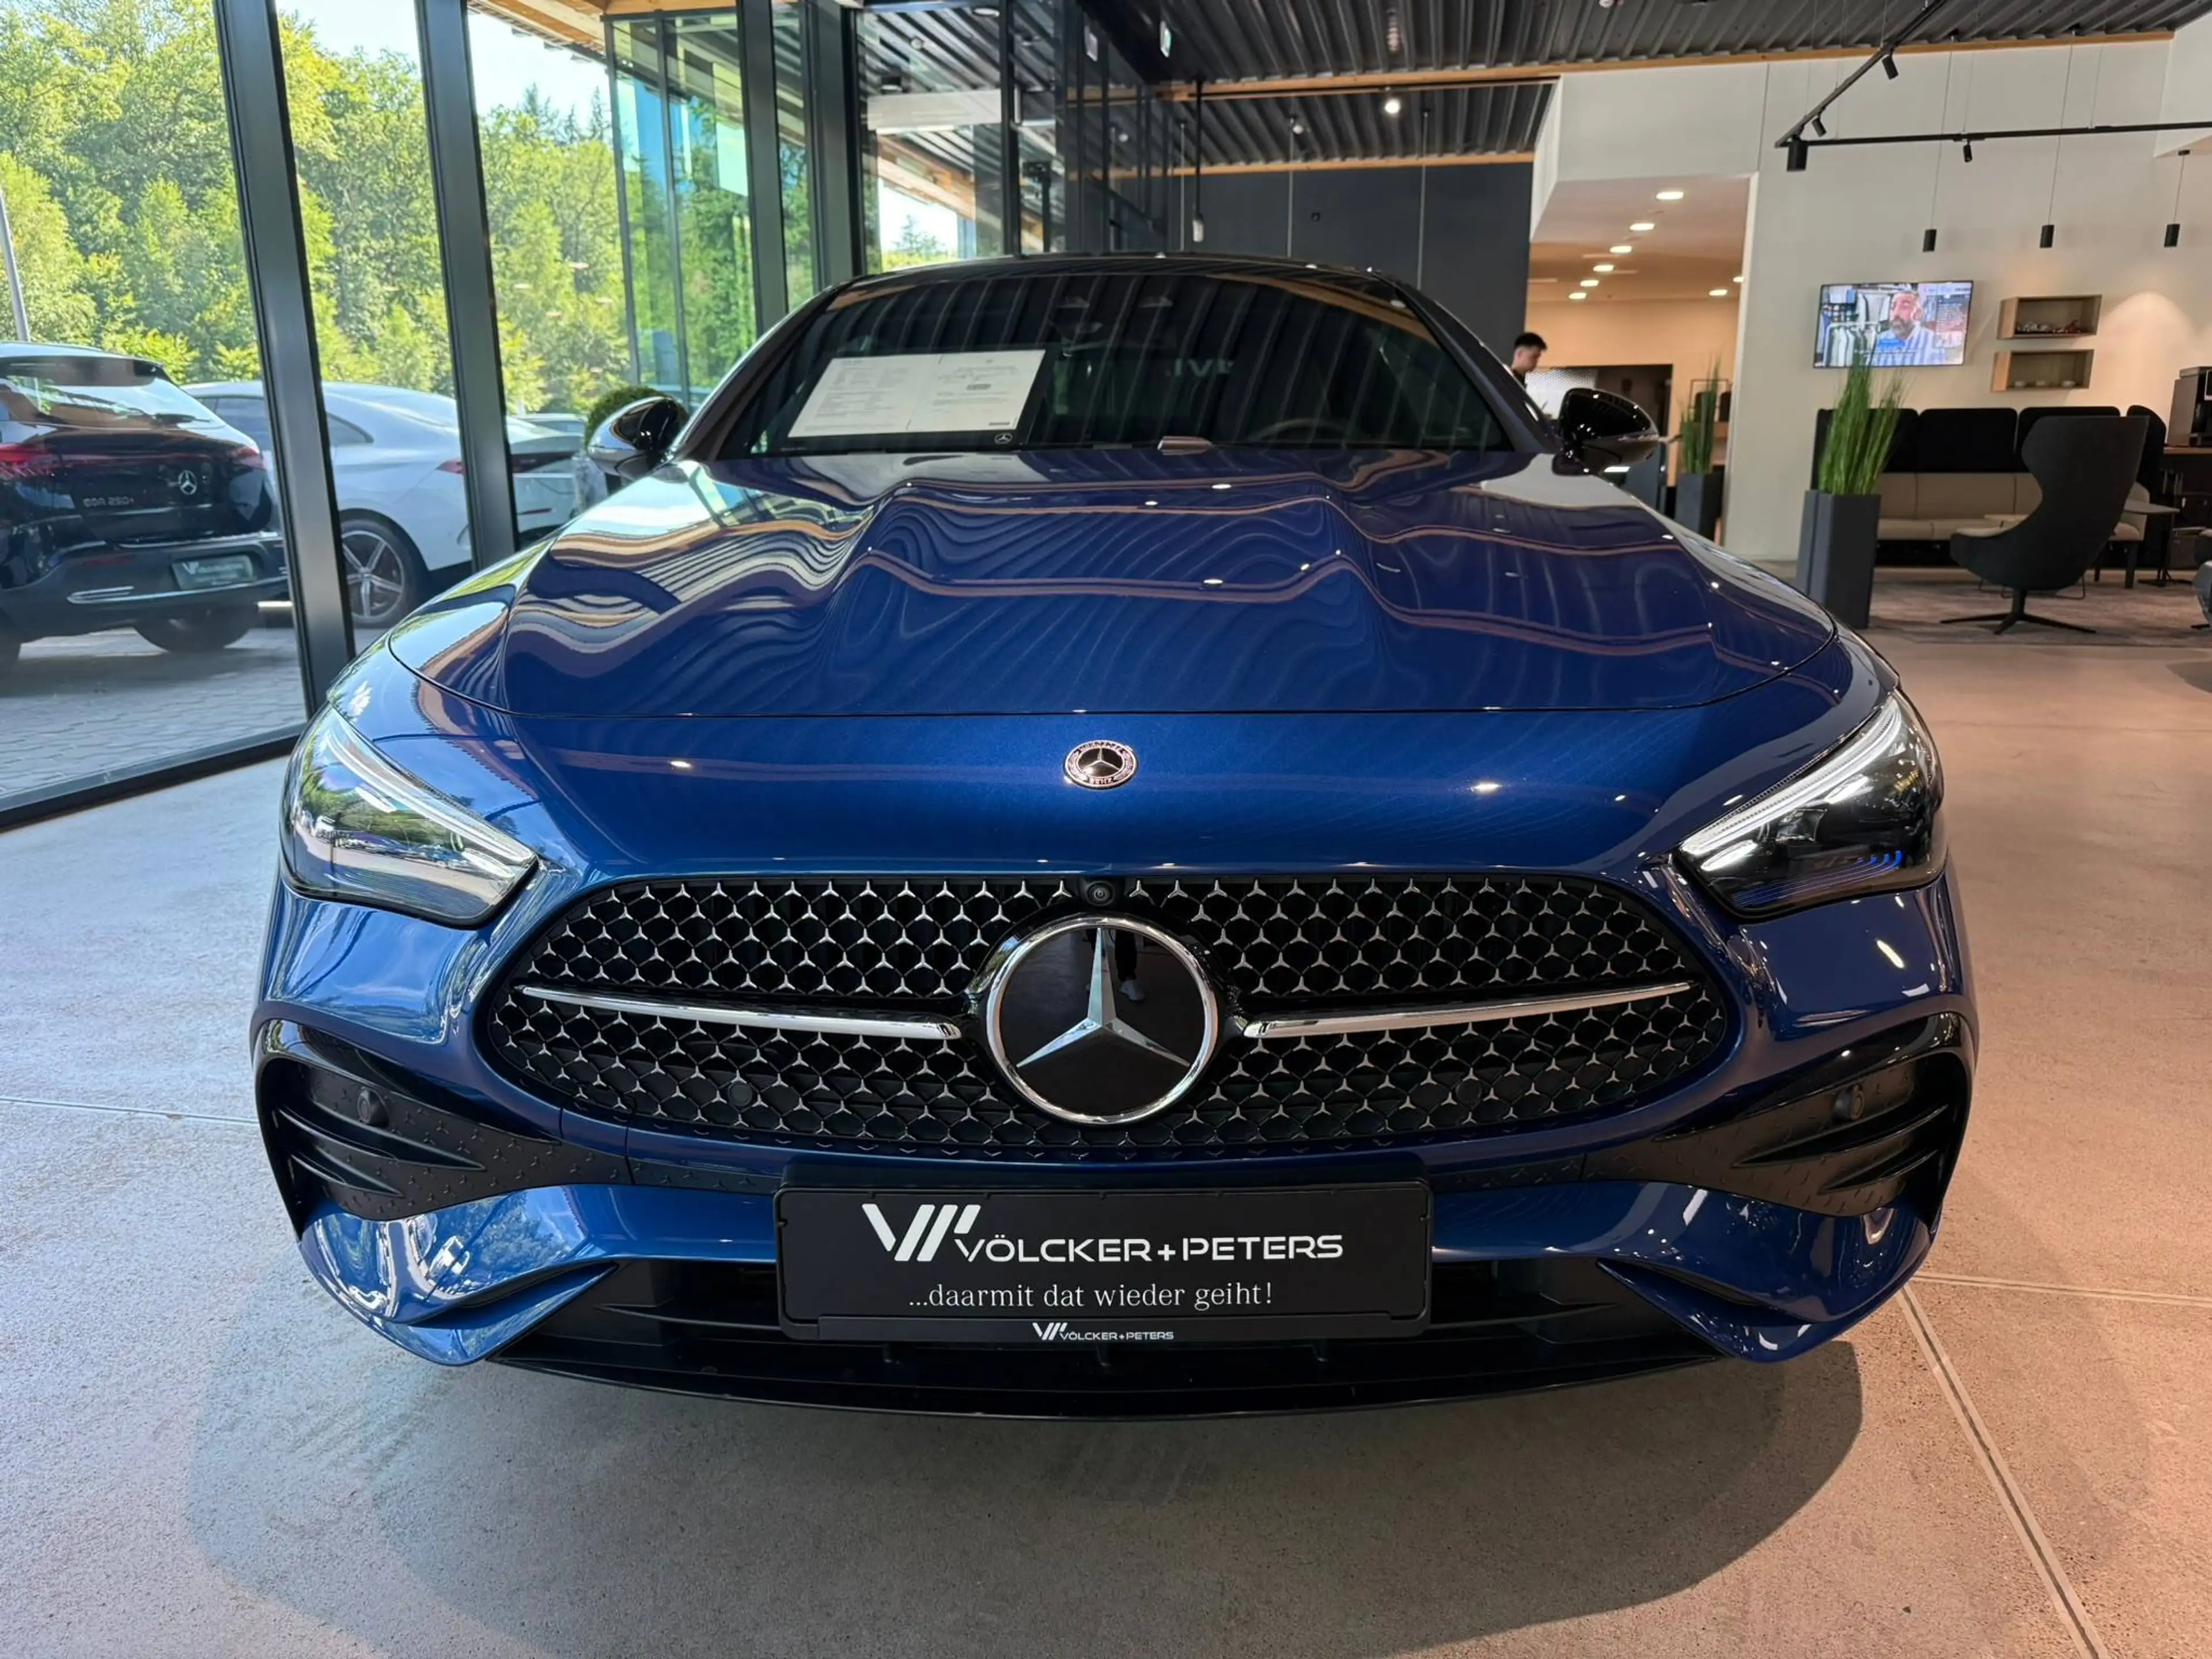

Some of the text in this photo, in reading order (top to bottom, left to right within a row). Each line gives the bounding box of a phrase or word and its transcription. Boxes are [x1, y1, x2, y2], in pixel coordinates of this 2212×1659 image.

[954, 1234, 1343, 1263] VÖLCKER+PETERS
[1043, 1284, 1084, 1307] dat
[1094, 1283, 1185, 1306] wieder
[1194, 1282, 1271, 1311] geiht!
